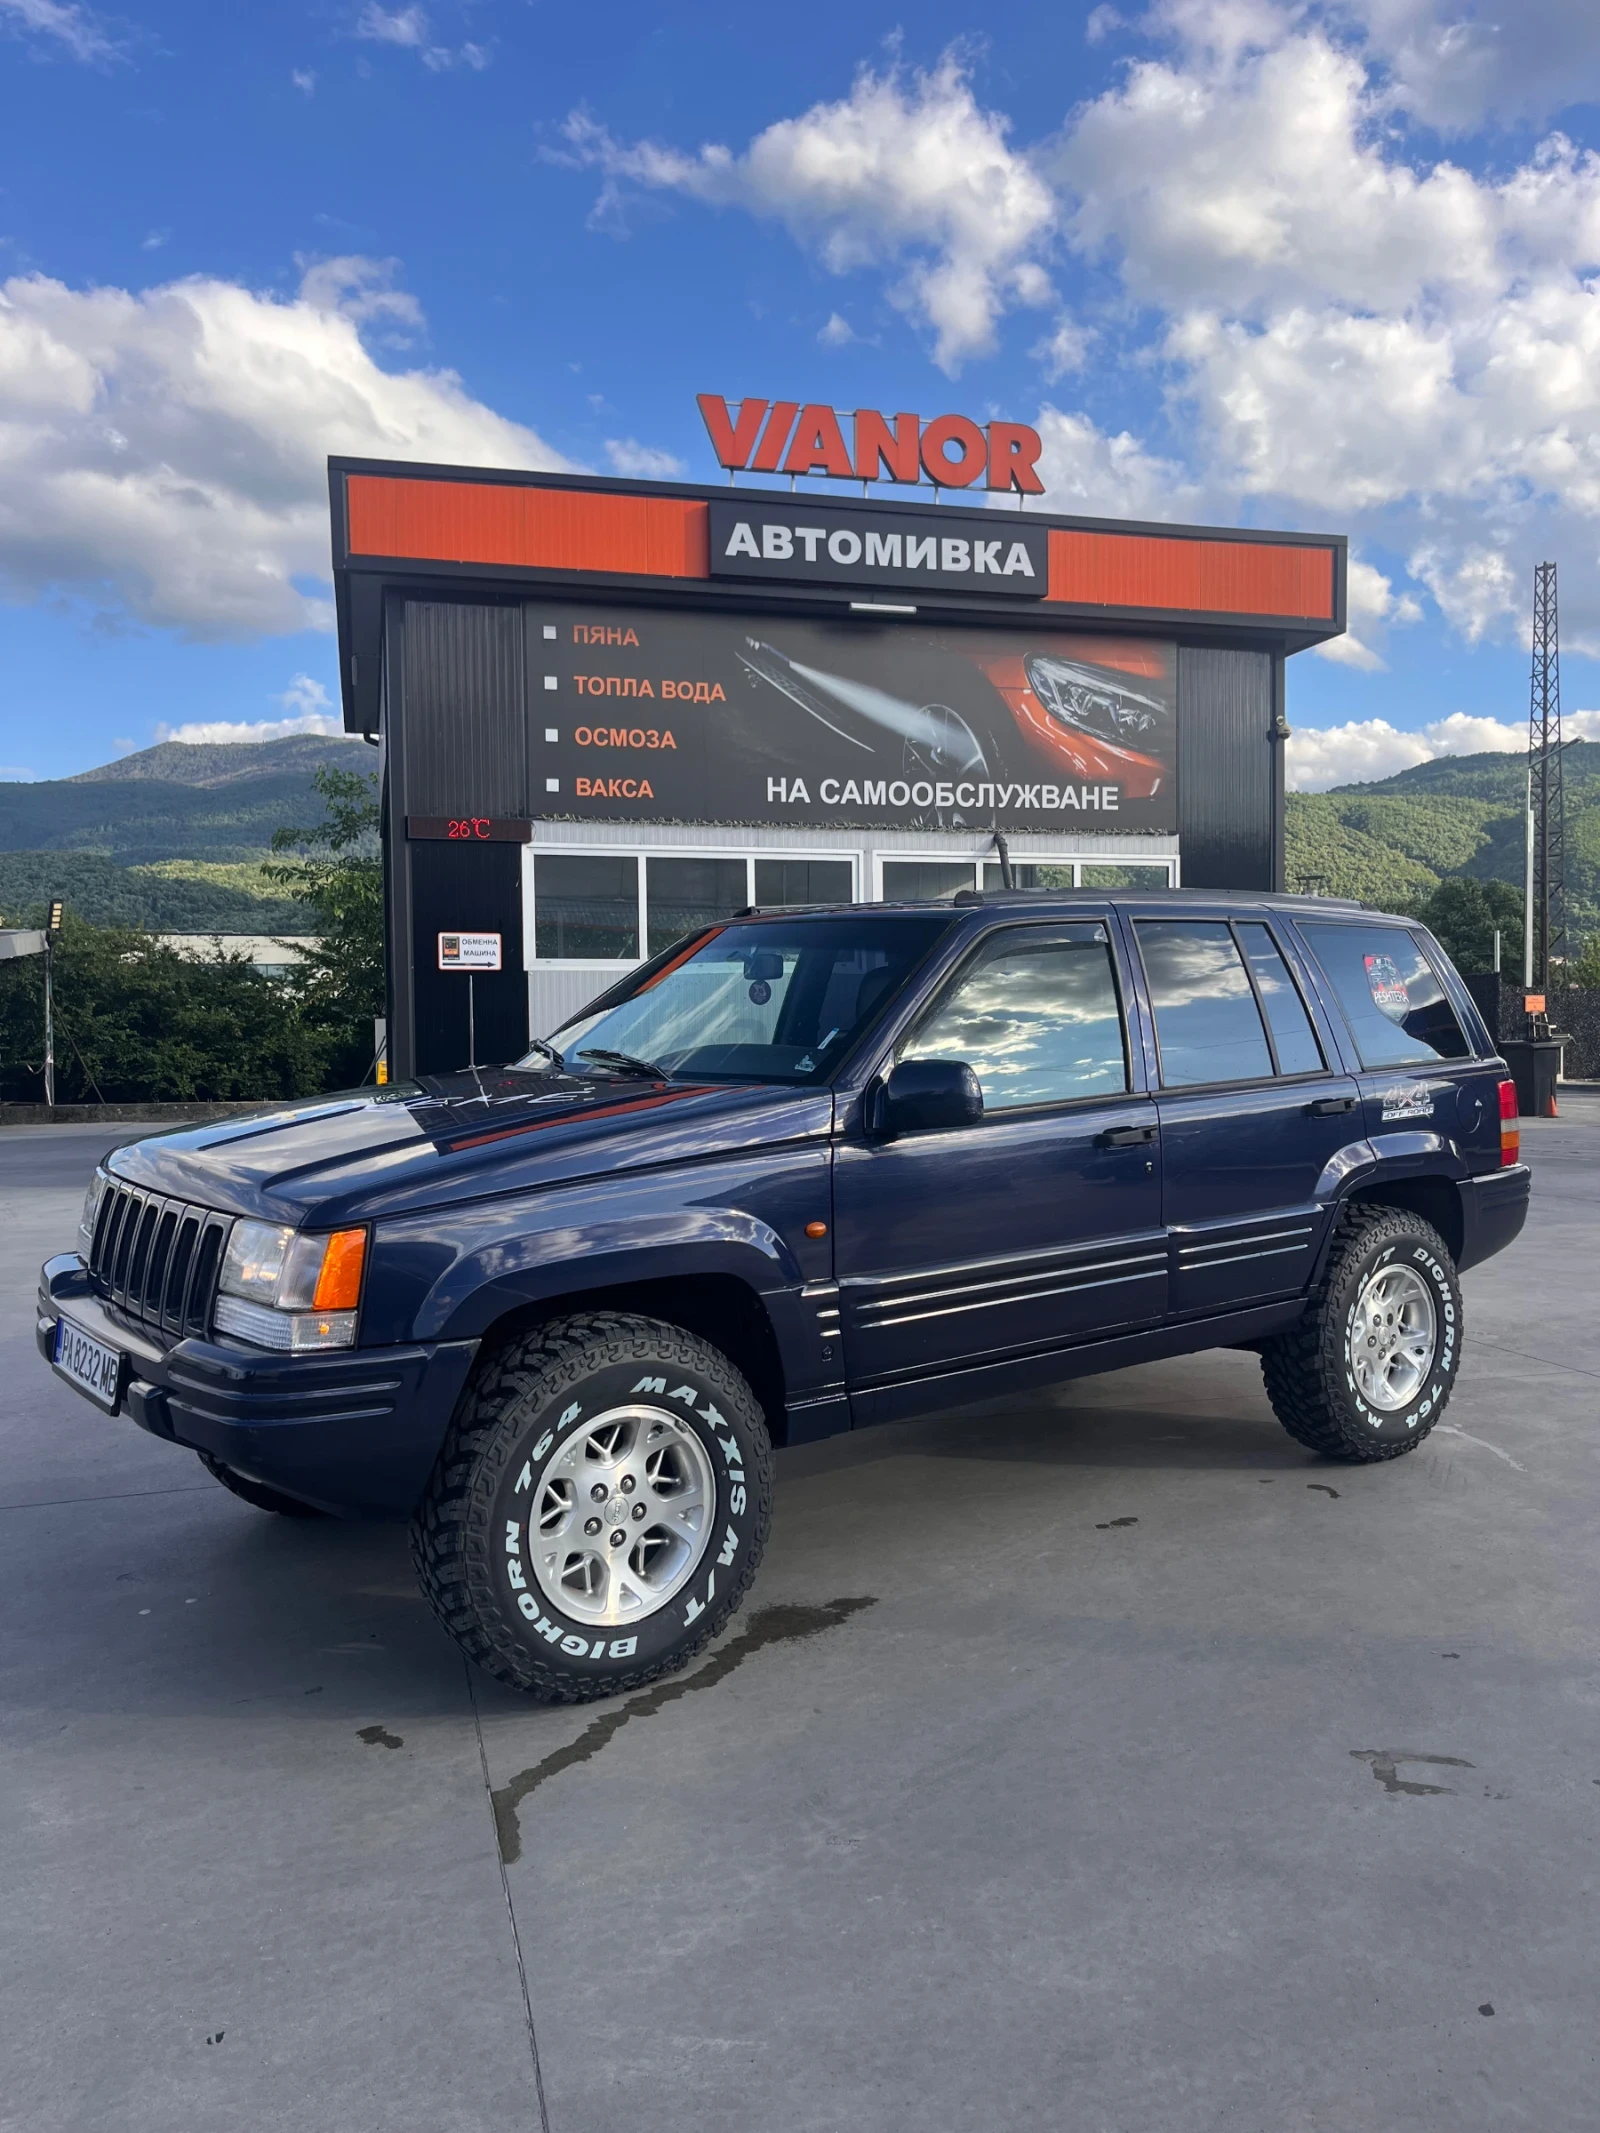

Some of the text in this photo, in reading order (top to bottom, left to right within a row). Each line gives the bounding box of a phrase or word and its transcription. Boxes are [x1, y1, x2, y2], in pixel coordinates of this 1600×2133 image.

[698, 394, 1044, 494] VIANOR
[724, 521, 1036, 577] АВТОМИВКА
[572, 625, 639, 647] ПЯНА
[573, 675, 726, 703] ТОПЛА ВОДА
[574, 727, 677, 750] ОСМОЗА
[575, 777, 654, 798] ВАКСА
[766, 776, 1120, 812] НА САМООБСЛУЖВАНЕ
[461, 938, 498, 946] ОБМЕННА
[463, 949, 497, 957] МАШИНА
[1413, 1247, 1455, 1372] BIGHORN
[74, 1337, 100, 1387] 8232
[629, 1376, 747, 1517] MAXXIS
[505, 1400, 638, 1660] BIGHORN 764
